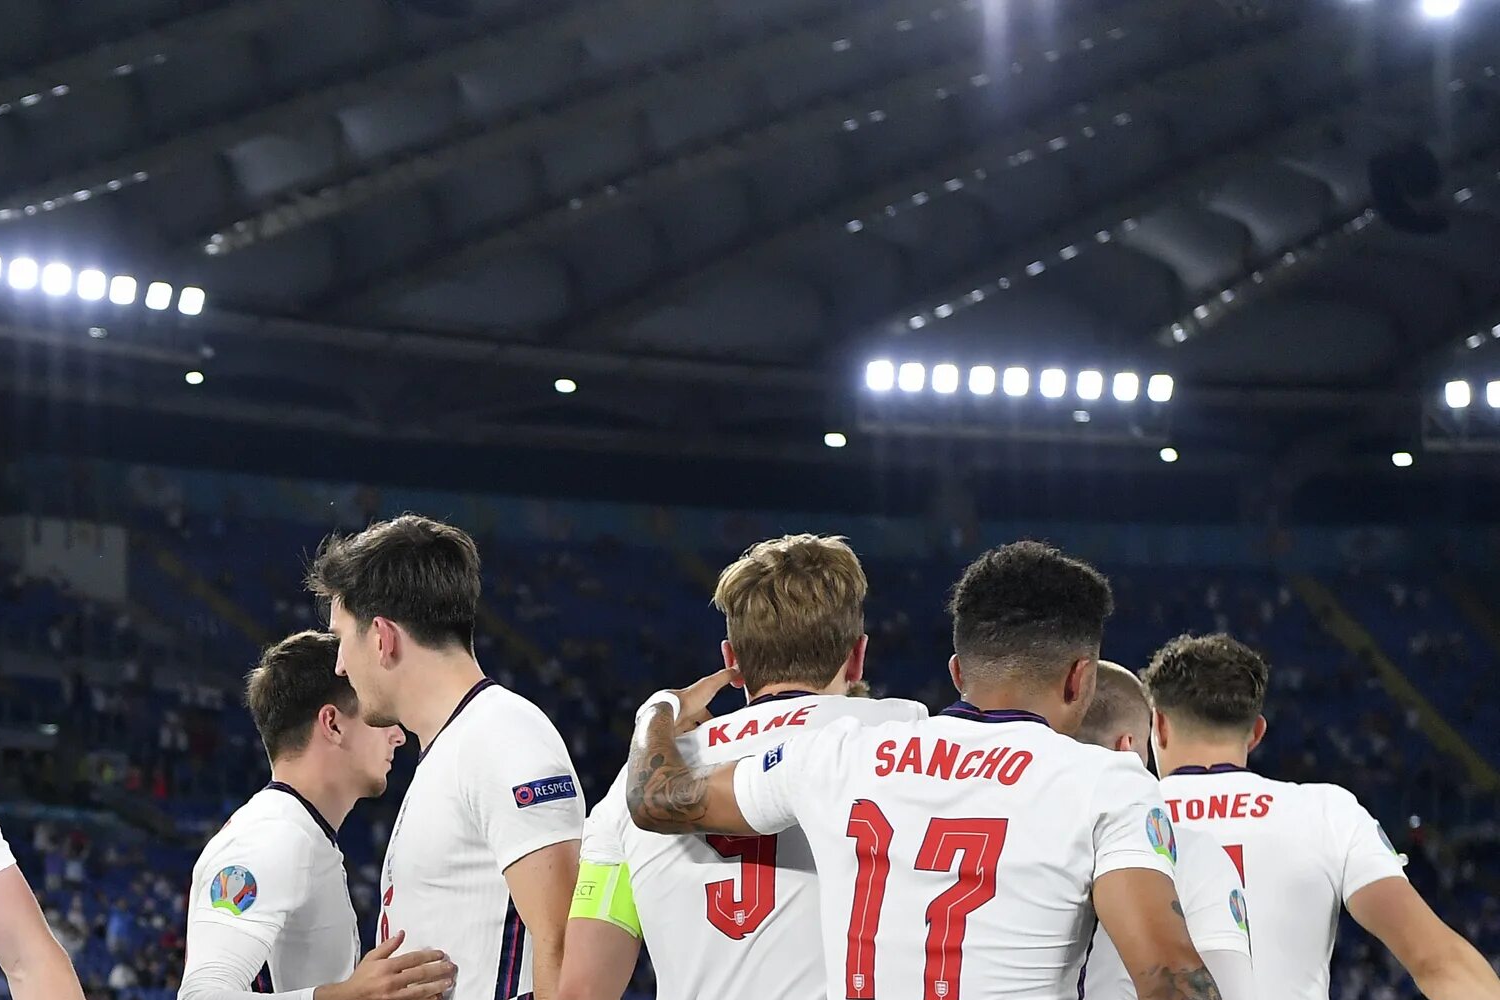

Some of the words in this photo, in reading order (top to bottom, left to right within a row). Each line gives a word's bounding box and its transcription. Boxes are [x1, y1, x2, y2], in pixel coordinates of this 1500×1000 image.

[708, 704, 818, 748] KANE
[875, 737, 1033, 786] SANCHO
[534, 781, 574, 798] RESPECT
